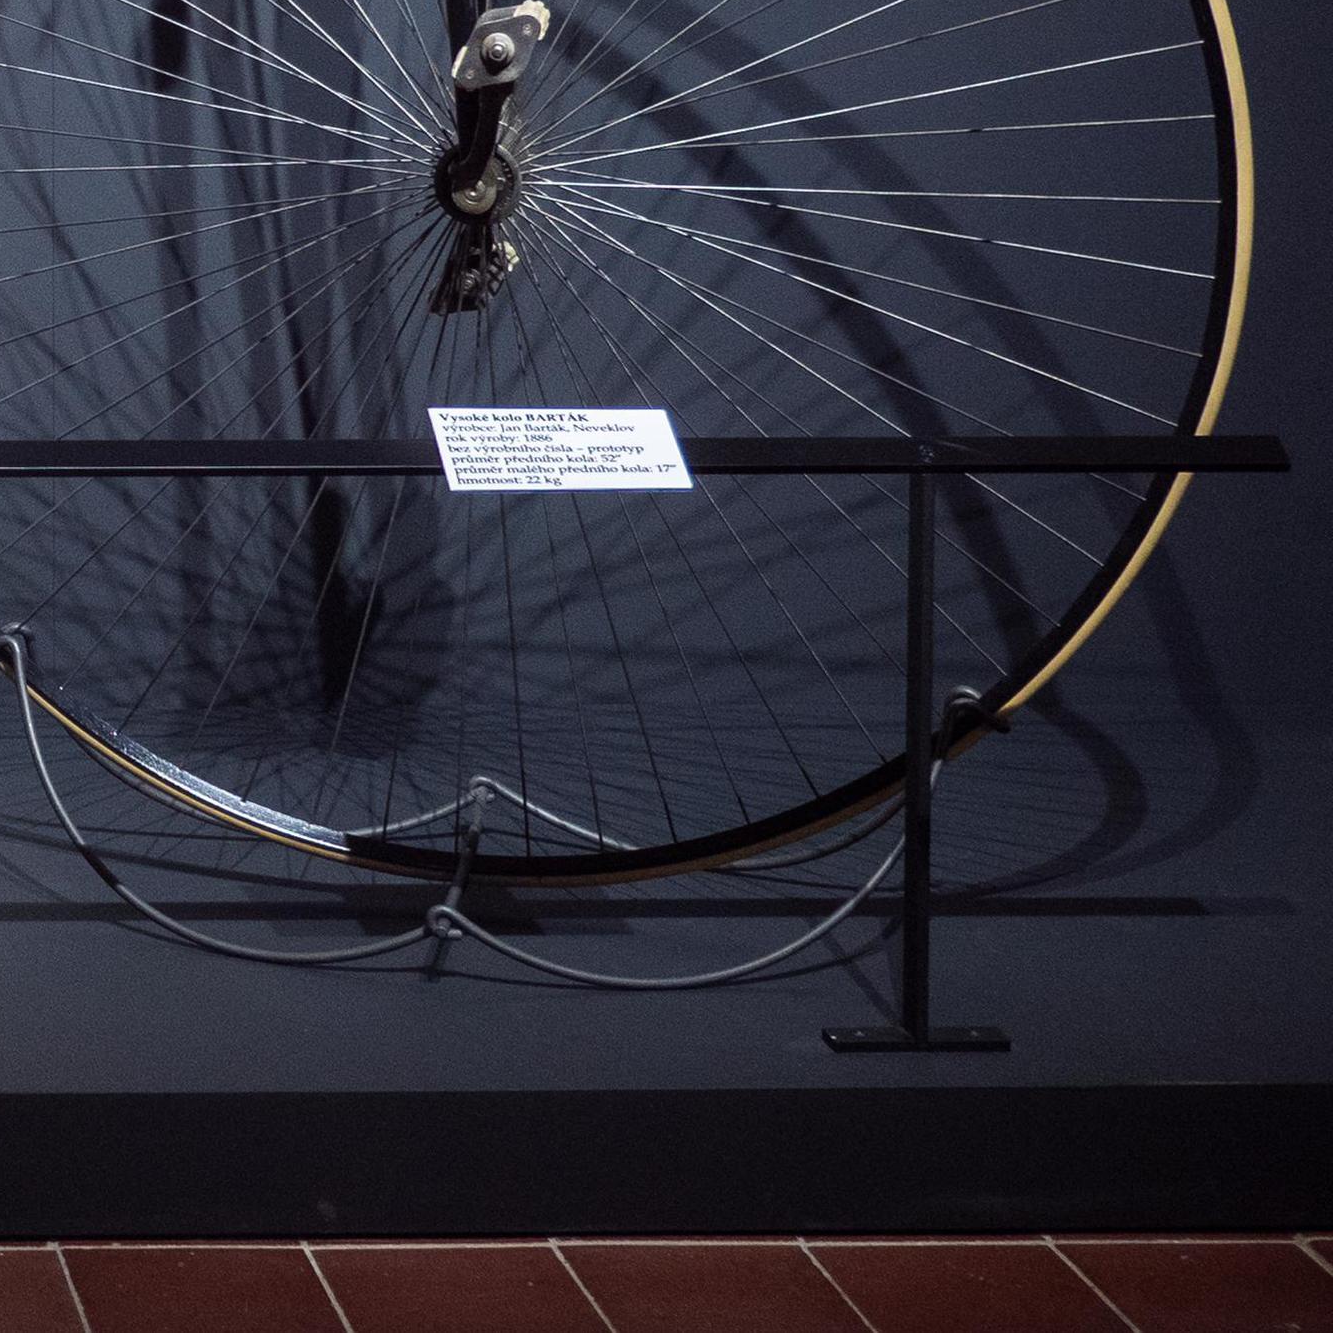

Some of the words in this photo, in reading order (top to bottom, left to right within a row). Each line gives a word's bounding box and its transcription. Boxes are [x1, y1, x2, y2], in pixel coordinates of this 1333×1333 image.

[439, 413, 490, 423] Vysoké
[492, 413, 522, 422] kolo
[525, 412, 589, 422] BARTÁK
[442, 423, 497, 433] výrobce:
[500, 424, 521, 433] Jan
[573, 424, 635, 432] Neveklov
[445, 434, 467, 442] rok
[470, 434, 520, 444] výroby:
[524, 434, 554, 442] 1886
[448, 444, 472, 453] bez
[474, 444, 541, 455] výrobního
[544, 444, 573, 453] čísla
[587, 445, 645, 455] prototyp
[451, 455, 500, 465] průměr
[504, 454, 563, 465] předního
[566, 454, 598, 463] kola:
[454, 465, 504, 475] průměr
[507, 465, 555, 473] malého
[558, 464, 619, 475] předního
[621, 464, 653, 473] kola:
[457, 475, 523, 484] hmotnost:
[526, 476, 541, 484] 22
[543, 475, 563, 487] kg
